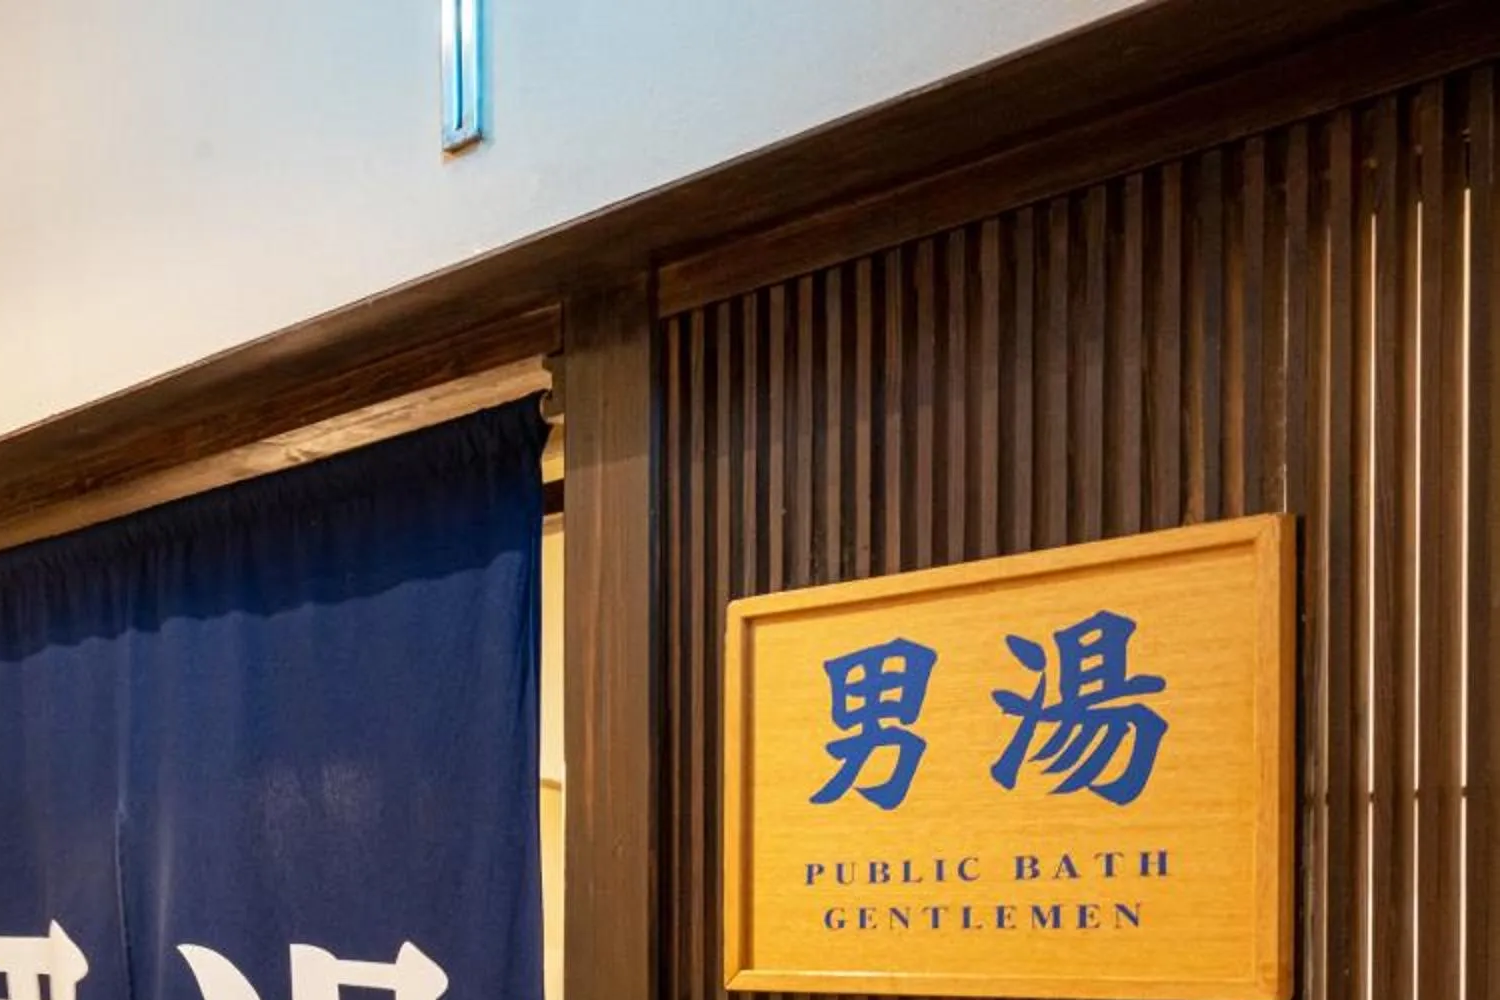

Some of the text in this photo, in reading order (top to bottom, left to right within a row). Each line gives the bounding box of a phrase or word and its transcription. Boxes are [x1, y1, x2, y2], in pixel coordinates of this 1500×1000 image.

[807, 608, 1169, 811] 男湯
[804, 849, 1170, 886] PUBLIC BATH
[823, 900, 1142, 931] GENTLEMEN
